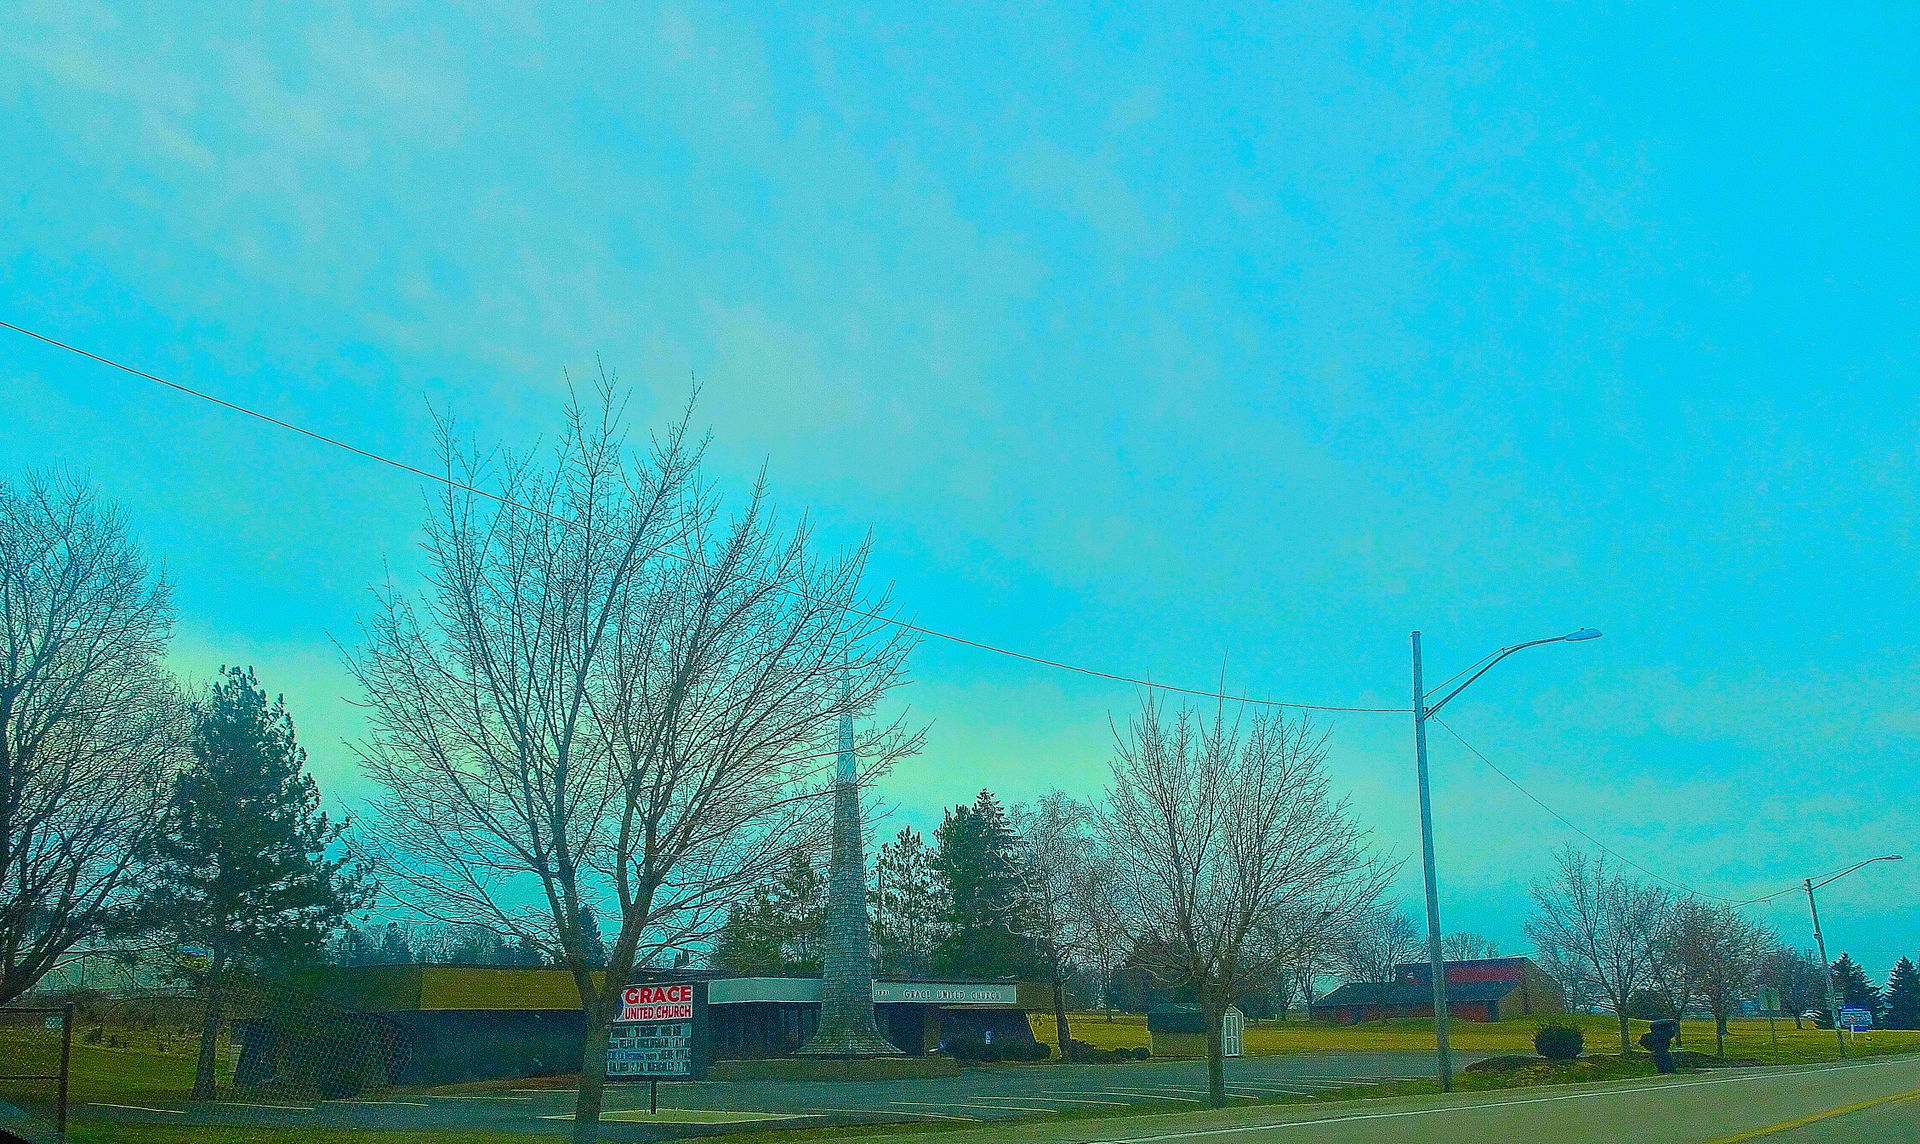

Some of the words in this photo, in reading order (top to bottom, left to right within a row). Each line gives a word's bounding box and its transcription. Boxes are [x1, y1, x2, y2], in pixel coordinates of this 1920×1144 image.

[625, 986, 692, 1005] GRACE
[904, 990, 931, 999] GRACE
[937, 990, 965, 999] UNITED
[971, 991, 1001, 1000] CHURCH
[625, 1007, 654, 1020] UNITED
[657, 1005, 691, 1019] CHURCH
